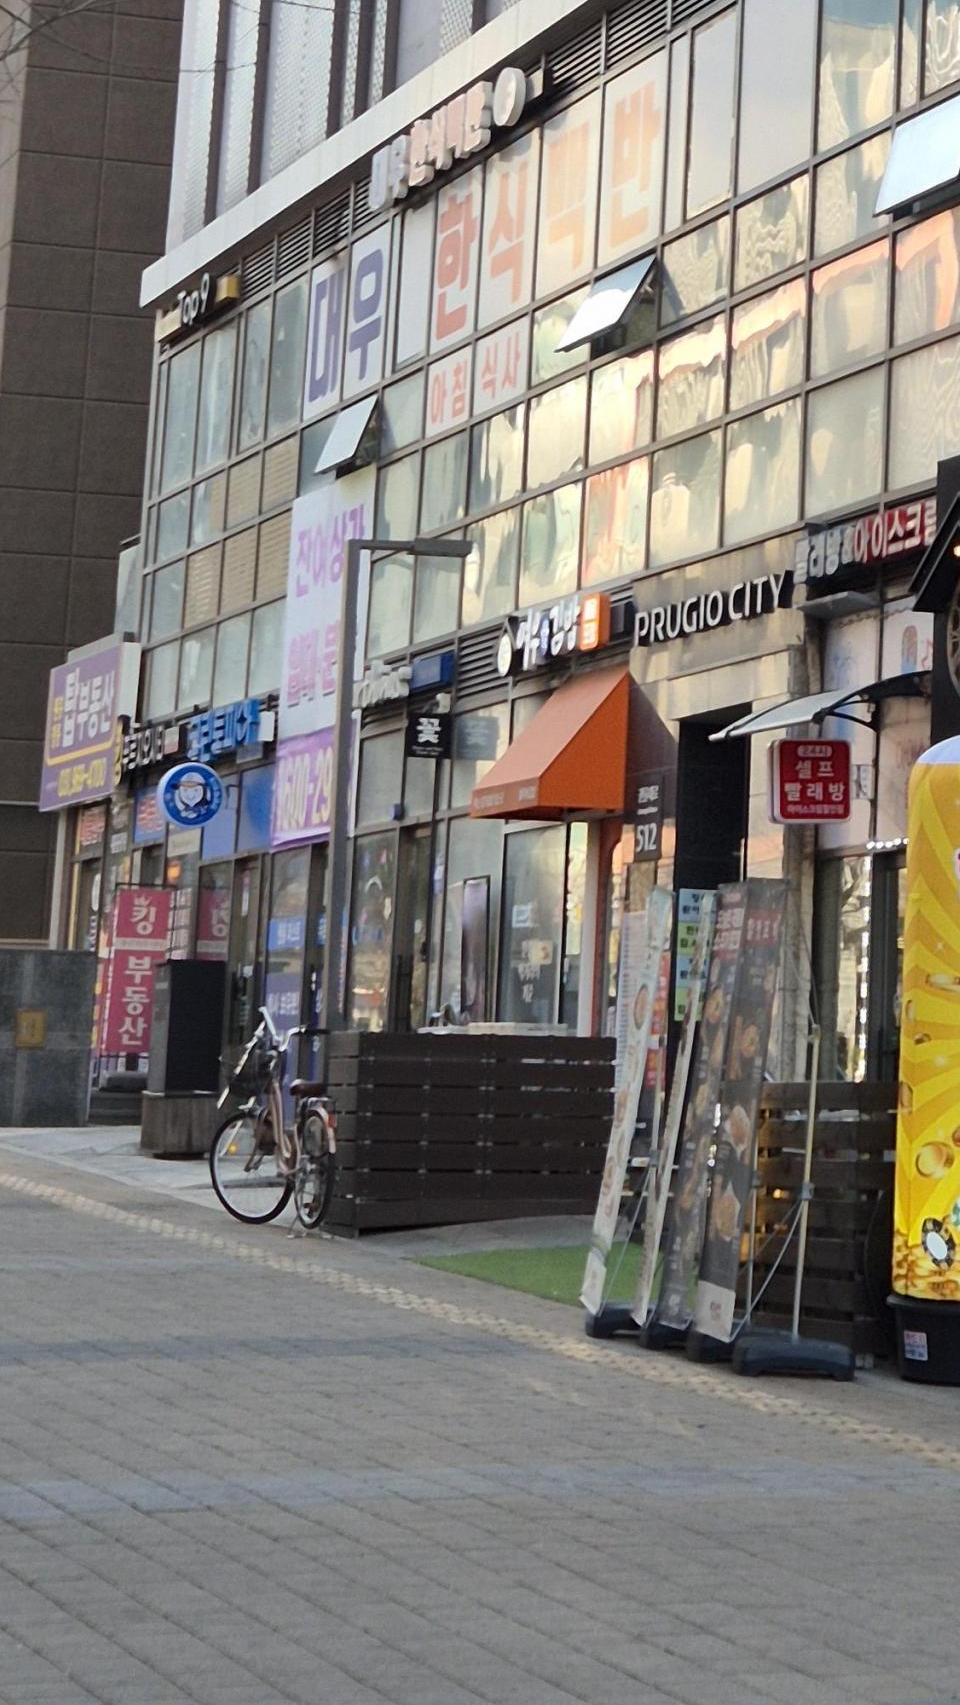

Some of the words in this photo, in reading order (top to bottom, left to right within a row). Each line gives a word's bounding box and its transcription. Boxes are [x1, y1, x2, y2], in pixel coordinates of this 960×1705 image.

[308, 248, 384, 403] 대우
[434, 82, 661, 341] 한식백반
[431, 358, 467, 426] 아침
[481, 332, 521, 399] 식사
[634, 589, 724, 646] PRUGIO
[728, 570, 786, 621] CITY
[784, 782, 846, 802] 빨래방
[795, 759, 835, 780] 셀프
[130, 906, 156, 936] 킹
[118, 955, 153, 1045] 부동산
